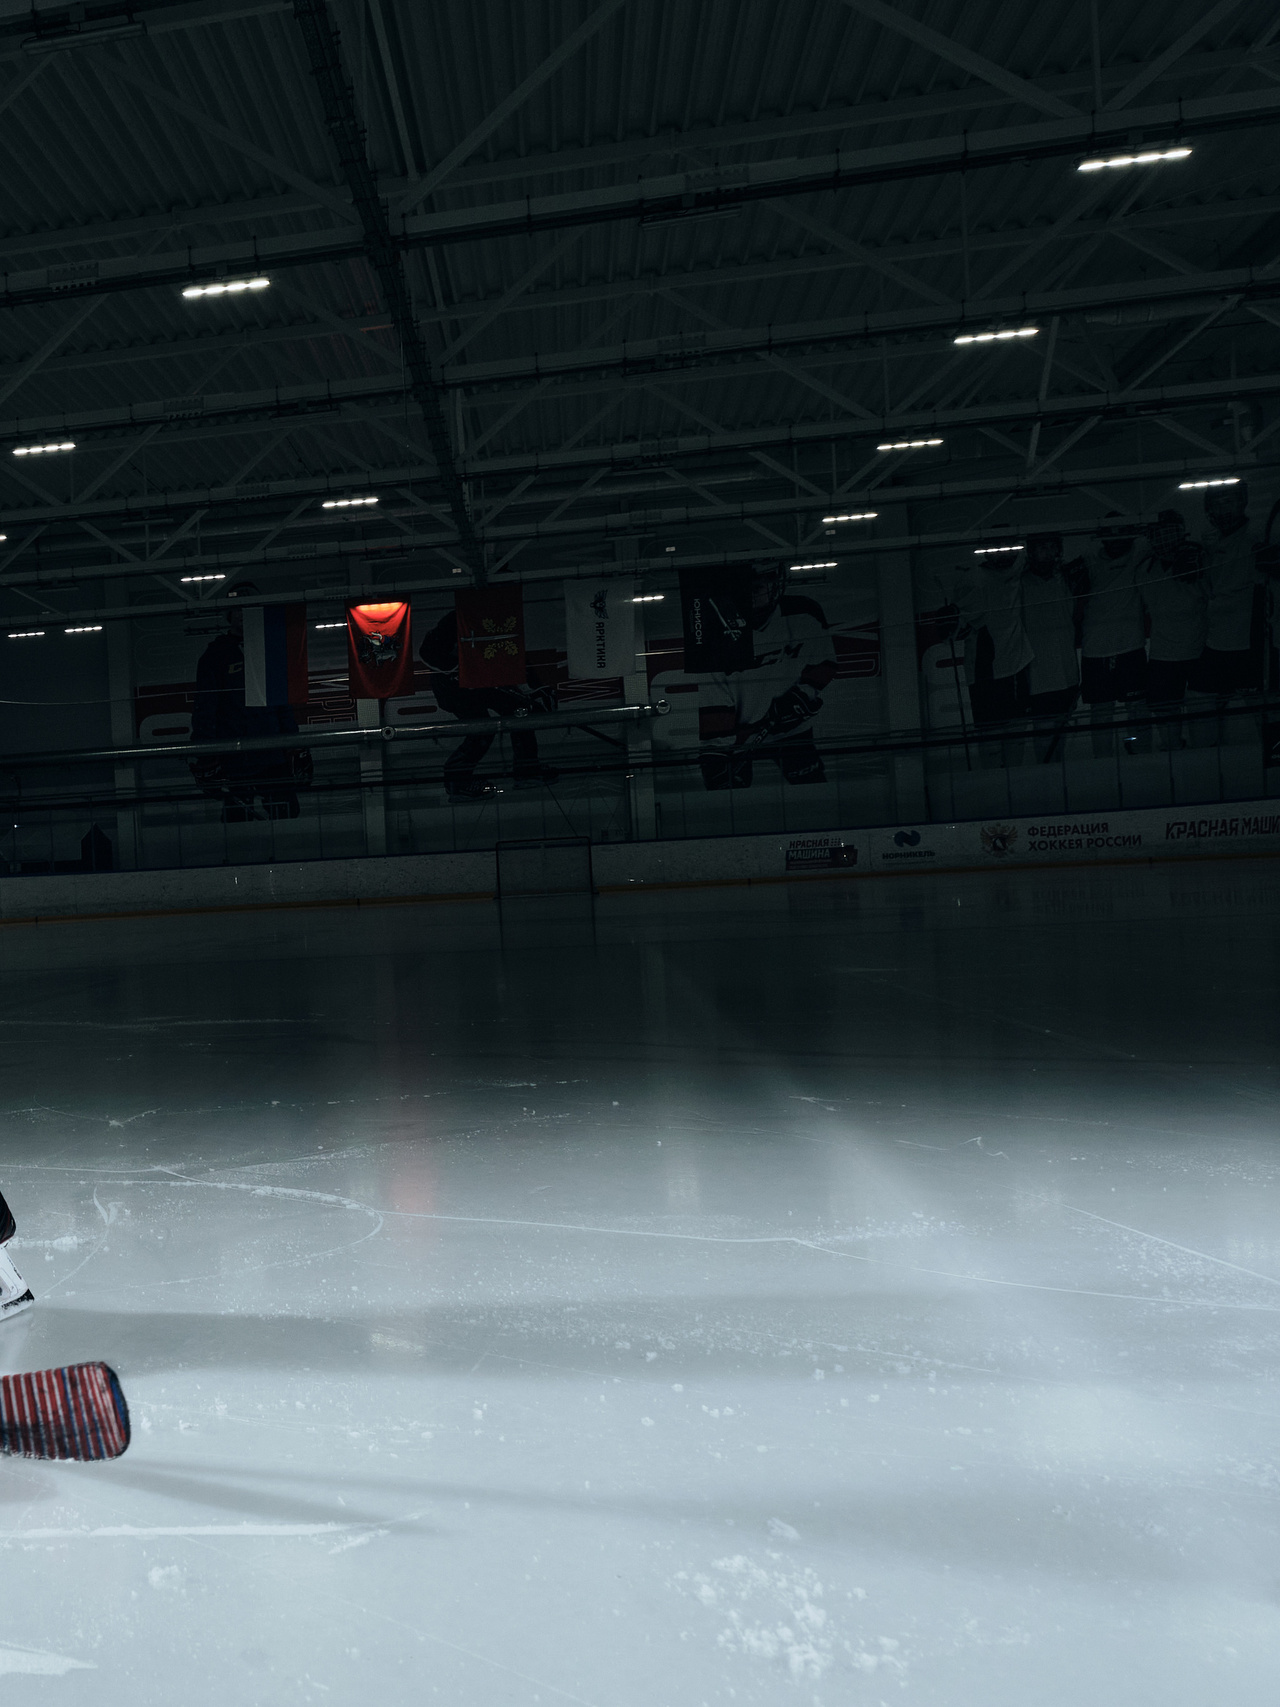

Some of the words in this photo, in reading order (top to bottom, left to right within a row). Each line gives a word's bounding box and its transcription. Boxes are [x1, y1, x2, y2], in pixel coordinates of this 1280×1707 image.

[595, 621, 606, 669] АРКТИКА
[1027, 822, 1109, 838] ФЕДЕРАЦИЯ
[1165, 817, 1239, 840] КРАСНАЯ
[789, 838, 830, 849] КРАСНАЯ
[1028, 838, 1083, 851] ХОККЕЯ
[1087, 834, 1142, 849] РОССИИ
[788, 848, 831, 861] МАШИНА
[882, 850, 936, 860] НОРНИКЕЛЬ
